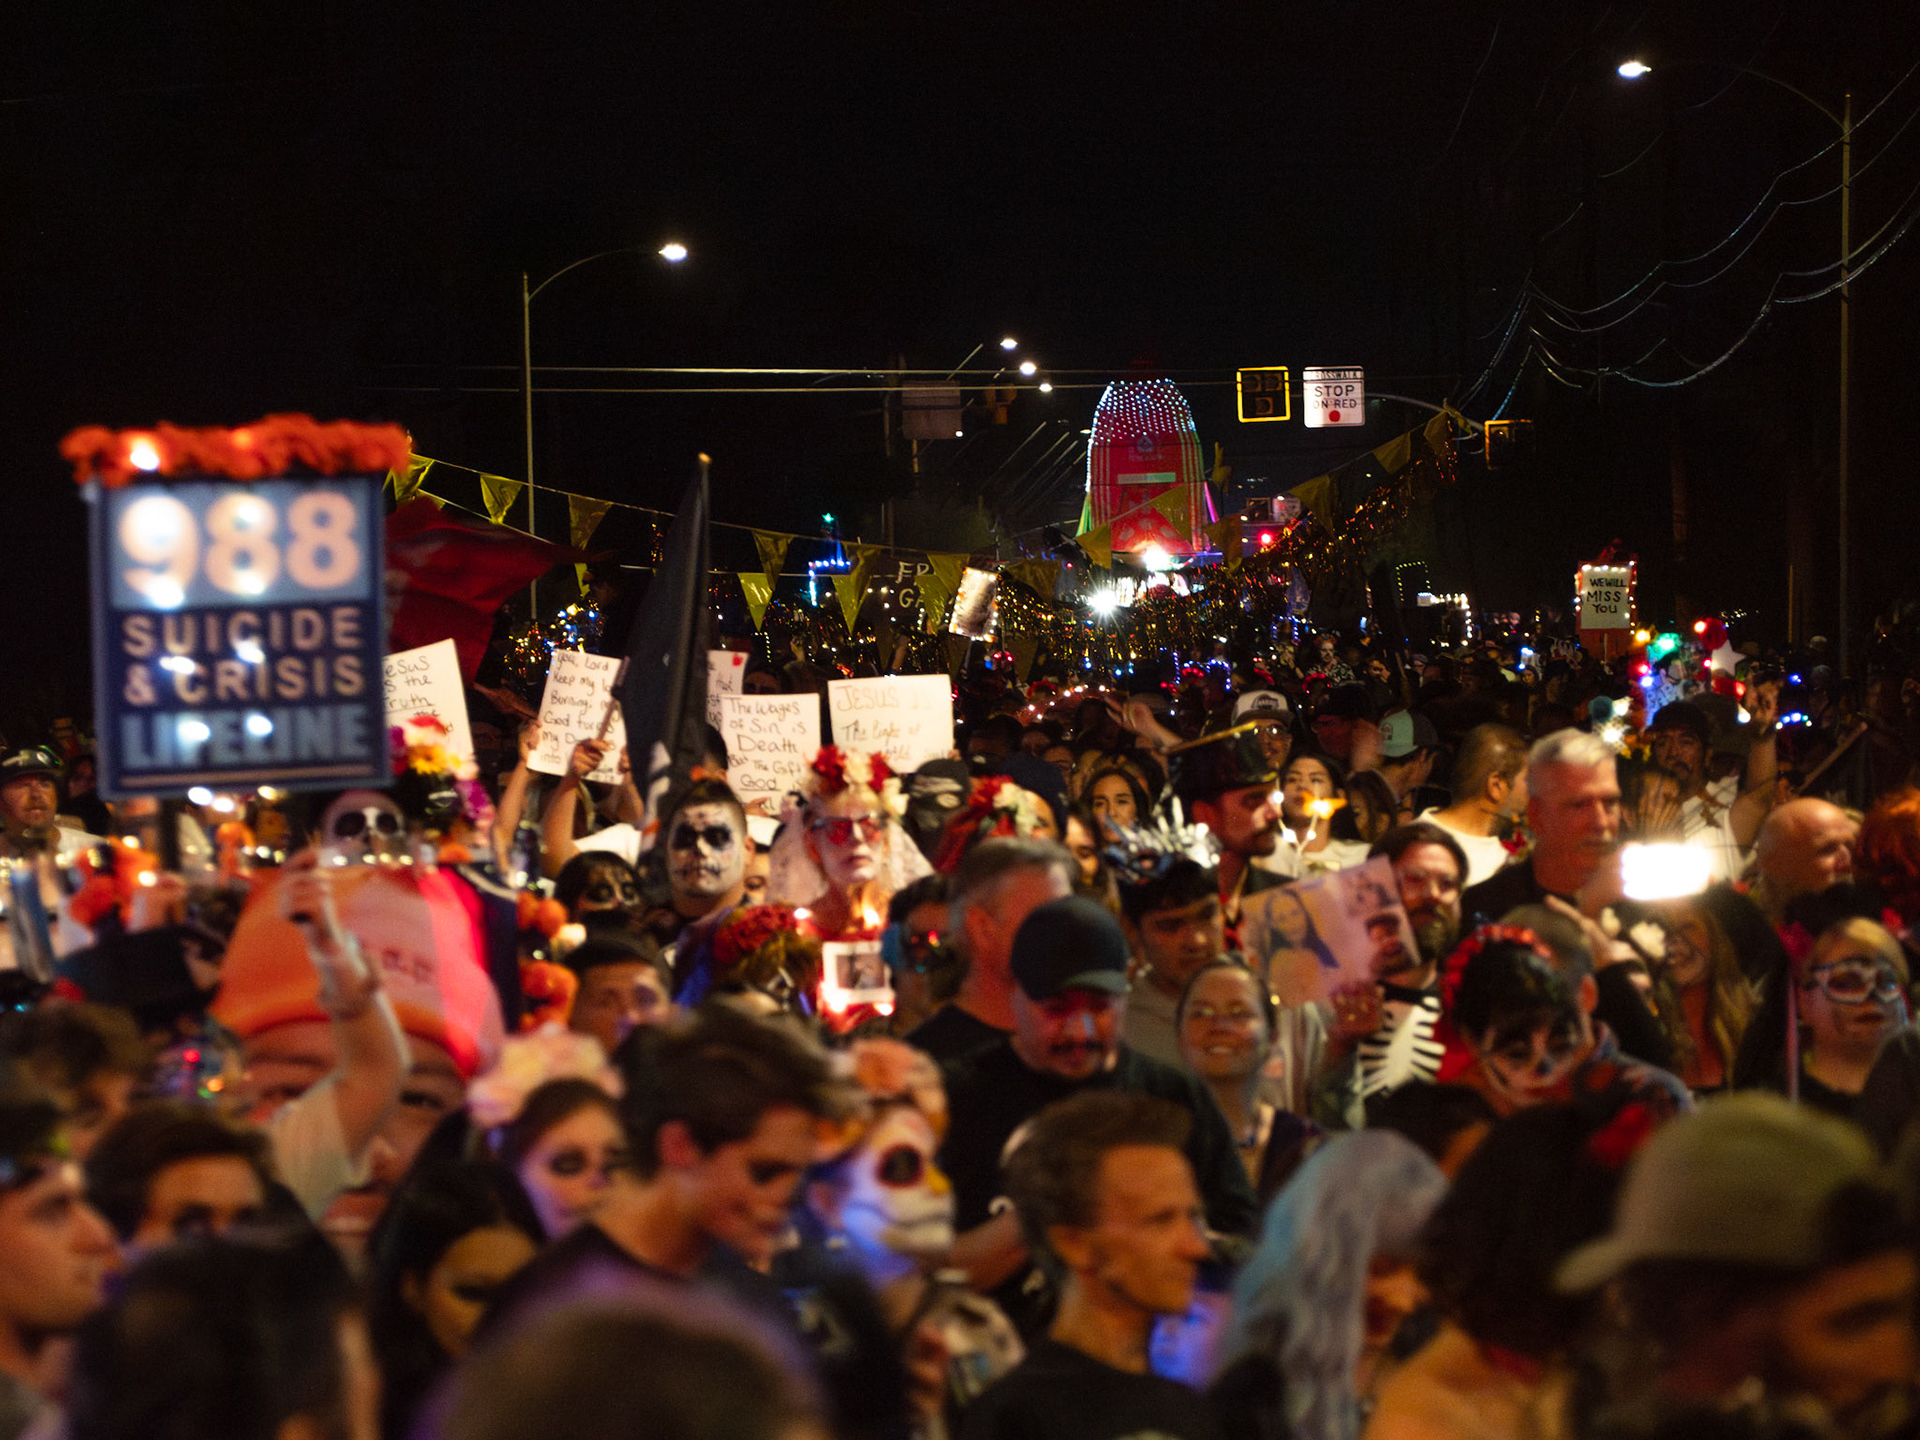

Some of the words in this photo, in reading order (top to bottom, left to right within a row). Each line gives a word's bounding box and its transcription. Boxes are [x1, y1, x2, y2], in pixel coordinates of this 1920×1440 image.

[1315, 385, 1354, 397] STOP
[1313, 399, 1328, 409] ON
[1334, 399, 1357, 409] RED
[119, 491, 360, 600] 988
[1586, 590, 1622, 603] MISS
[122, 607, 363, 658] SUICIDE
[124, 662, 157, 706] &
[172, 655, 366, 704] CRISIS
[404, 675, 432, 686] the
[383, 693, 435, 709] ruth
[835, 685, 900, 712] JESUS
[543, 711, 570, 727] God
[120, 704, 370, 768] LIFELINE
[737, 734, 799, 754] Death
